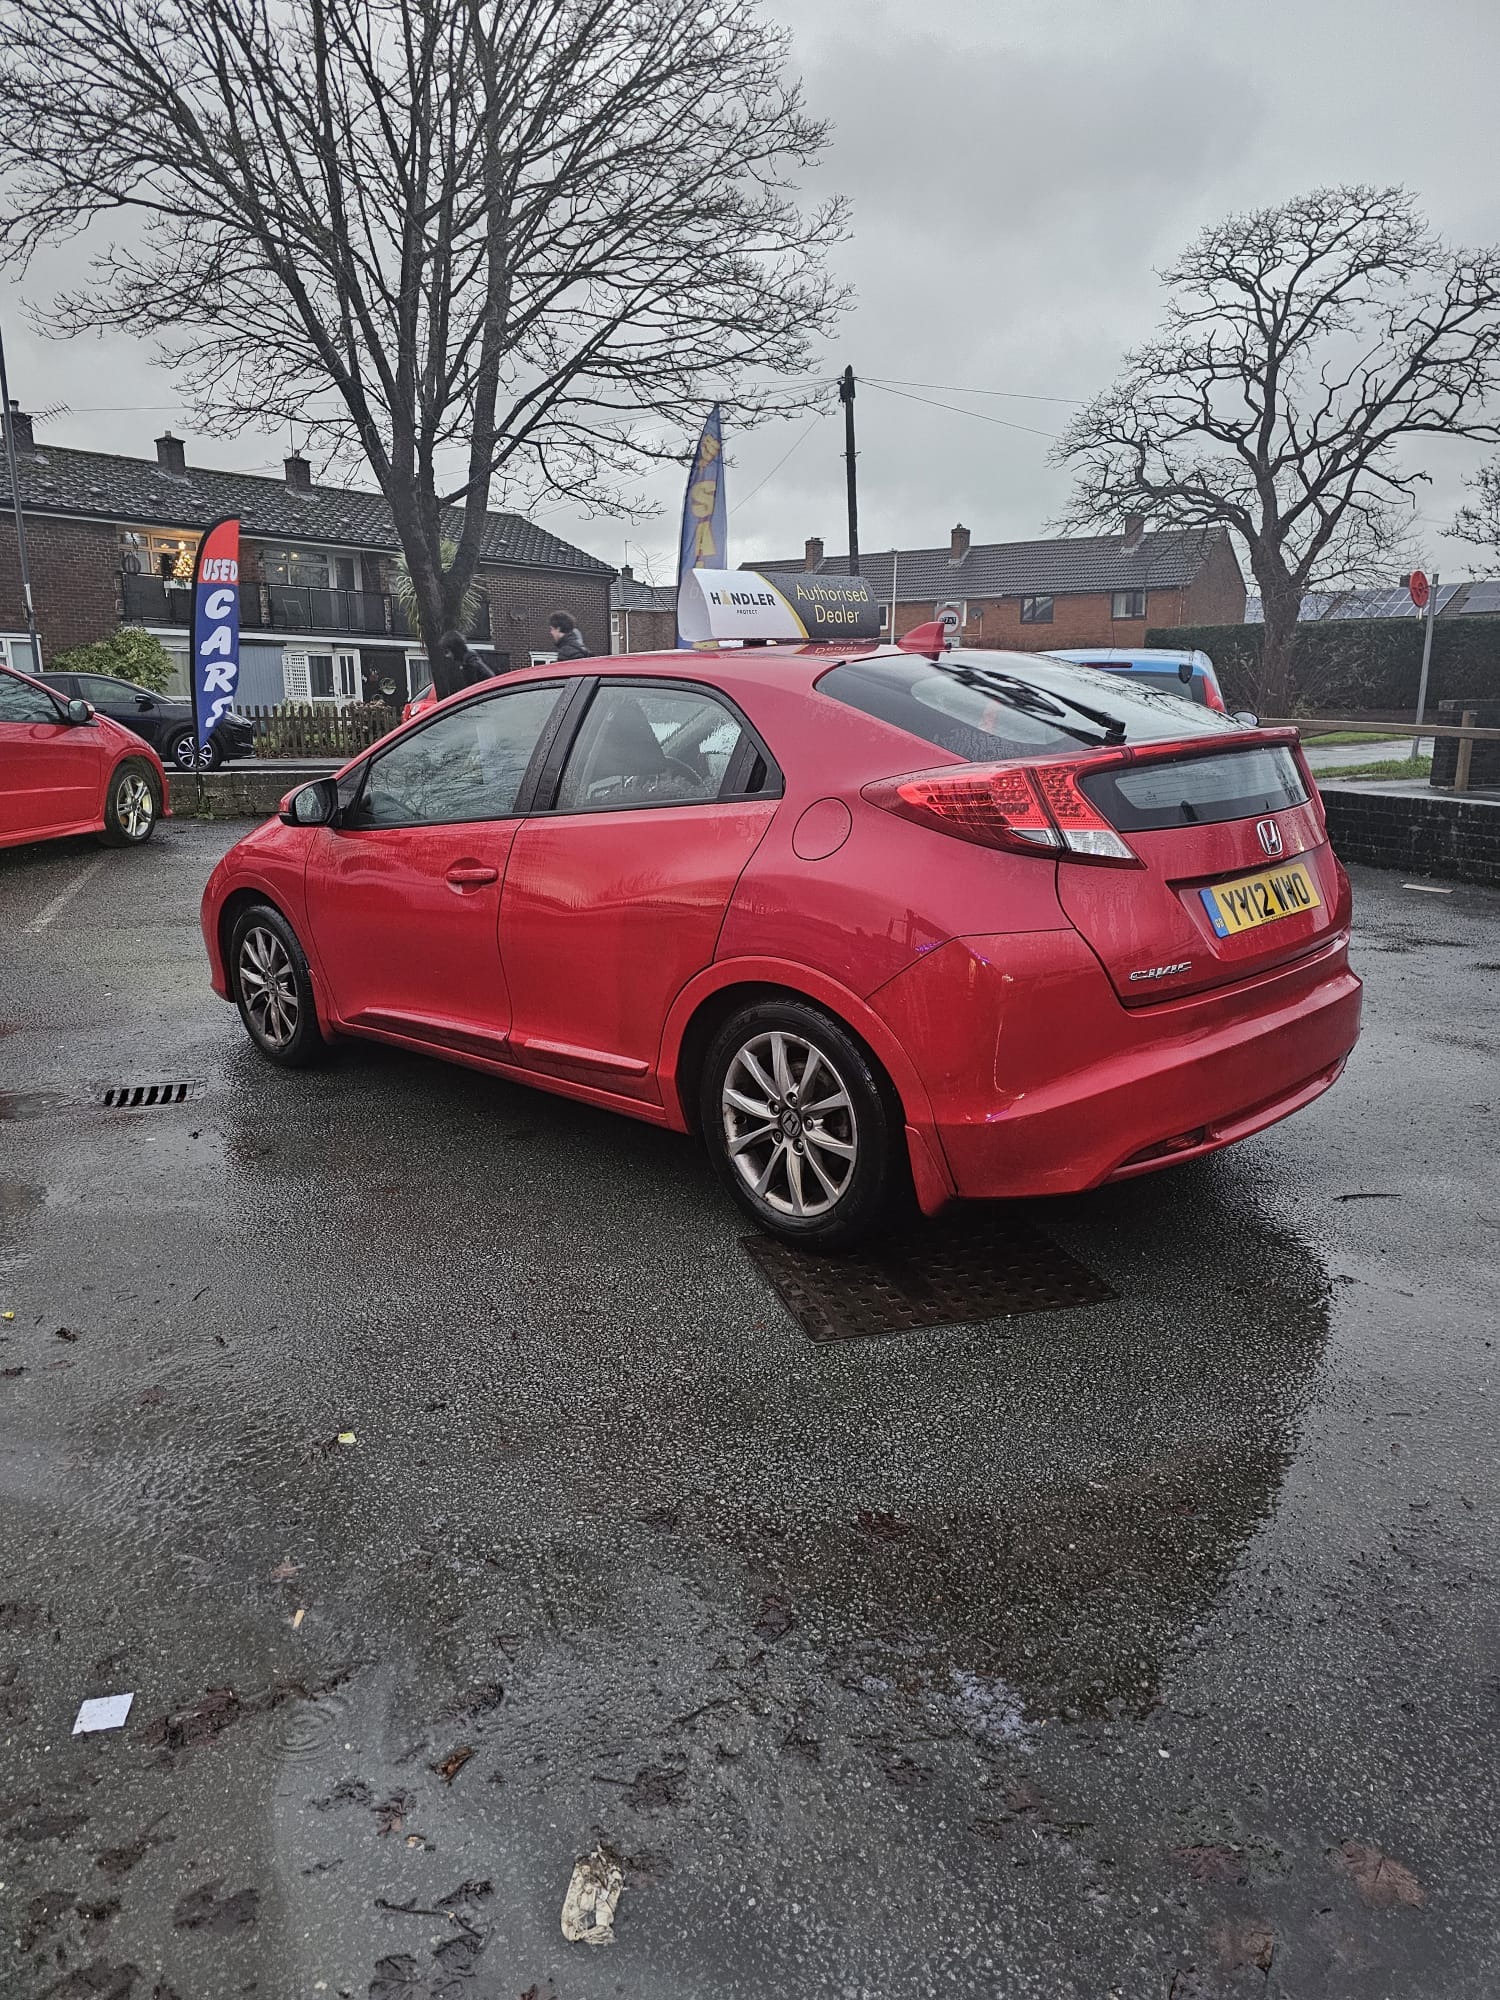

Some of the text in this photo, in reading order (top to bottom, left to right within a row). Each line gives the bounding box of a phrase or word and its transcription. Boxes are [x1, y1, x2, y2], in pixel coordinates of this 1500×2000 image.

[202, 558, 239, 581] USED
[796, 583, 869, 602] Authorised
[814, 604, 860, 624] Dealer
[200, 588, 237, 728] CARS
[1221, 872, 1311, 926] YY12 WHO
